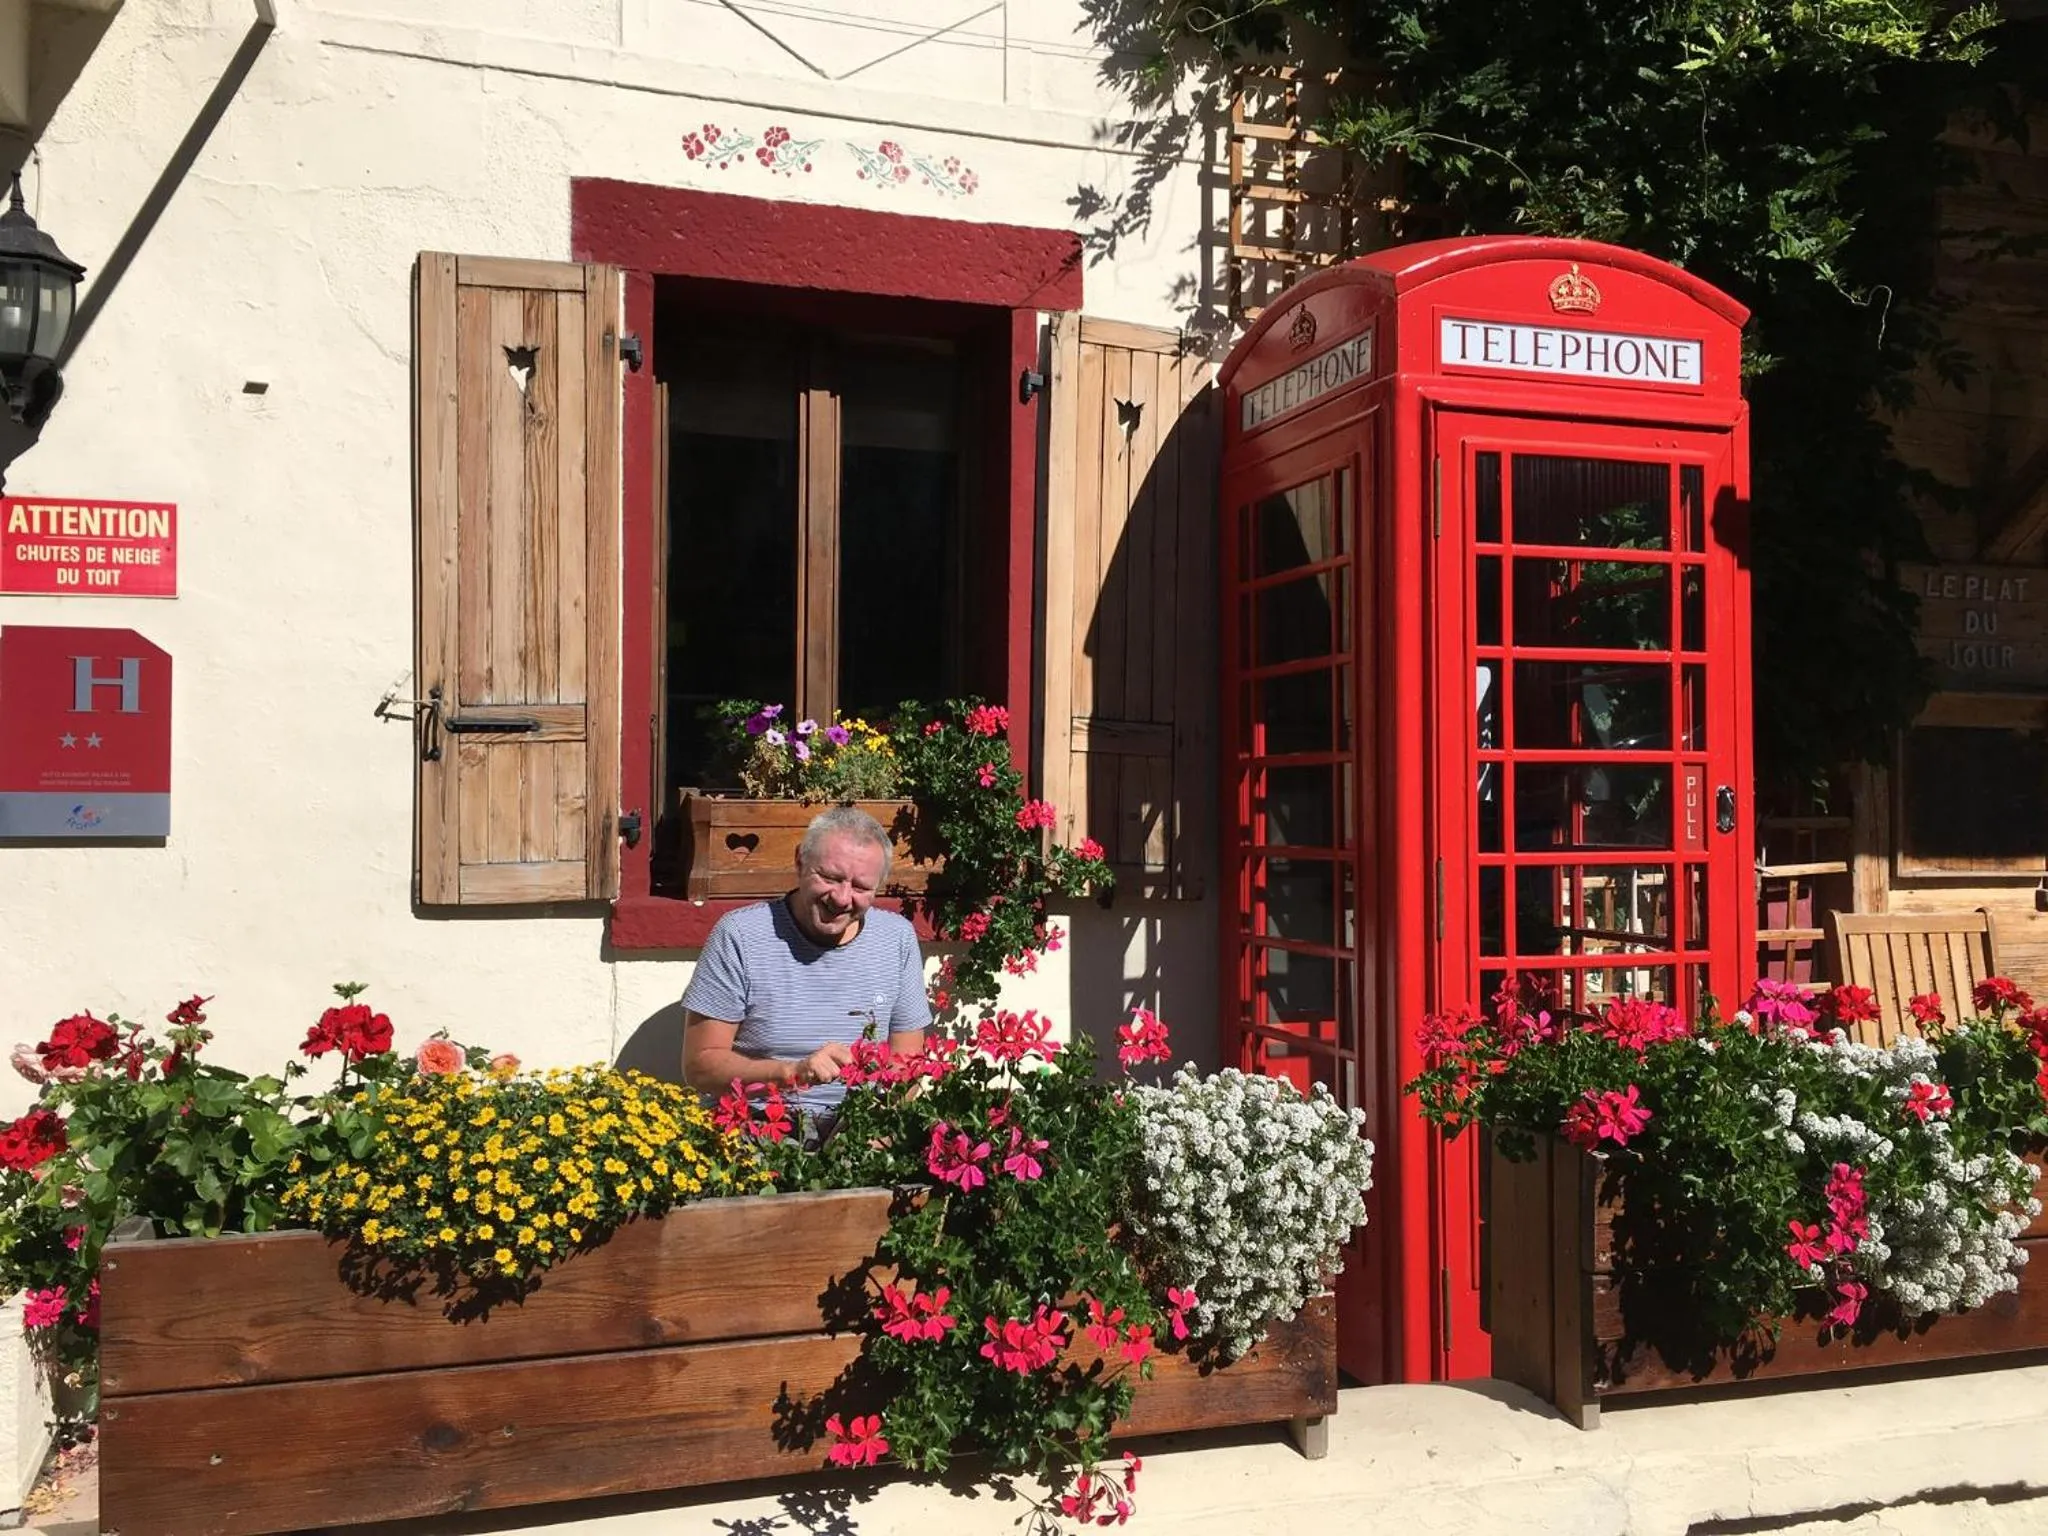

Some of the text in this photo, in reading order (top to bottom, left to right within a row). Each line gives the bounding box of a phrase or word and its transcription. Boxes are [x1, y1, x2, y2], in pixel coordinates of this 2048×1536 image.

[1450, 322, 1692, 381] TELEPHONE
[1245, 334, 1371, 424] TELEPHONE
[8, 505, 170, 538] ATTENTION
[16, 544, 161, 565] CHUTES DE NEIGE
[57, 569, 121, 586] DU TOIT
[1926, 575, 2029, 601] LE PLAT
[1965, 611, 1998, 634] DU
[1949, 646, 2015, 669] JOUR
[66, 655, 148, 713] H
[1687, 776, 1697, 839] PULL
